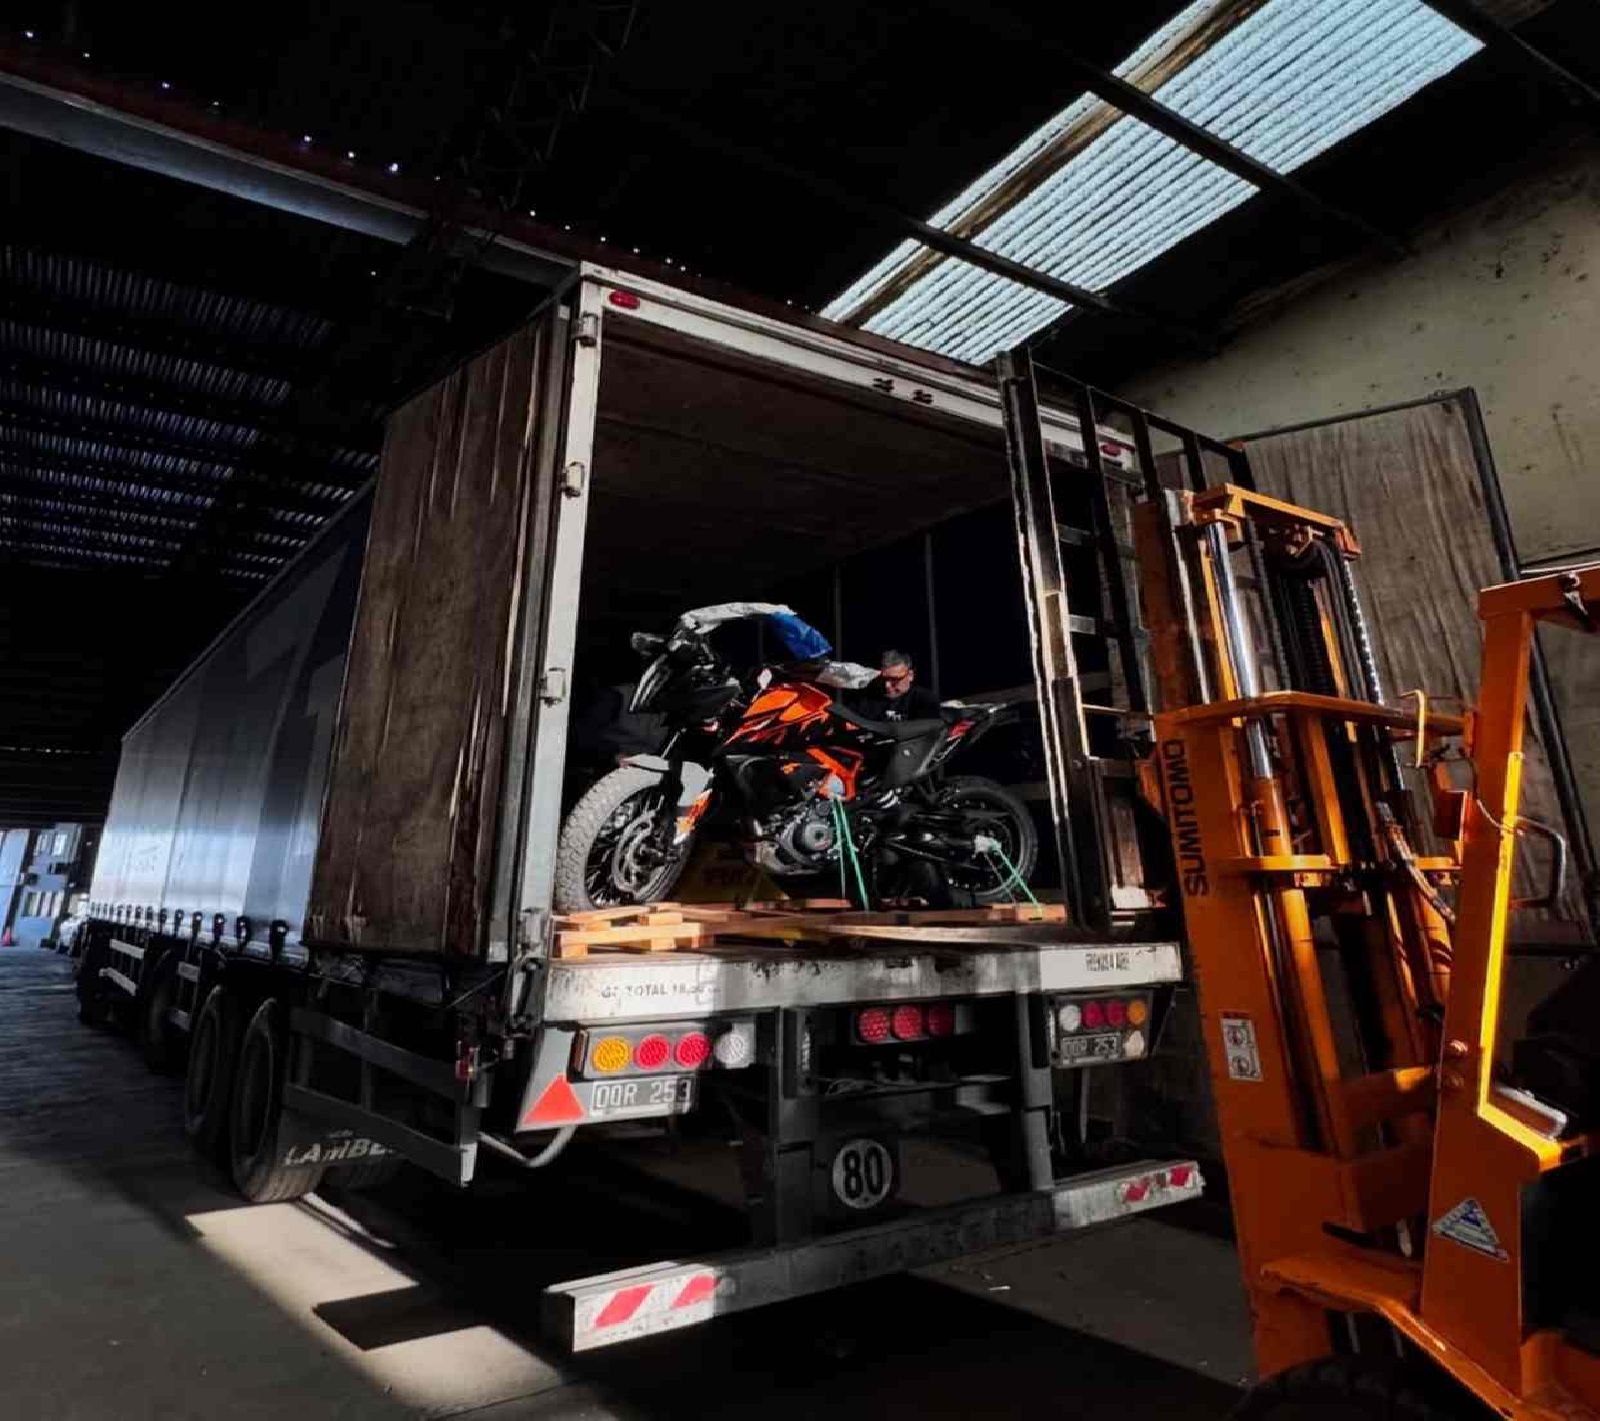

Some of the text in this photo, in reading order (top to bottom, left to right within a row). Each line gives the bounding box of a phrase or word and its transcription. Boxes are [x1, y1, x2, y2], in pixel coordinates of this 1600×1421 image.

[1163, 738, 1209, 896] SUMITOMO
[649, 1079, 692, 1103] 253
[844, 1146, 884, 1199] 80
